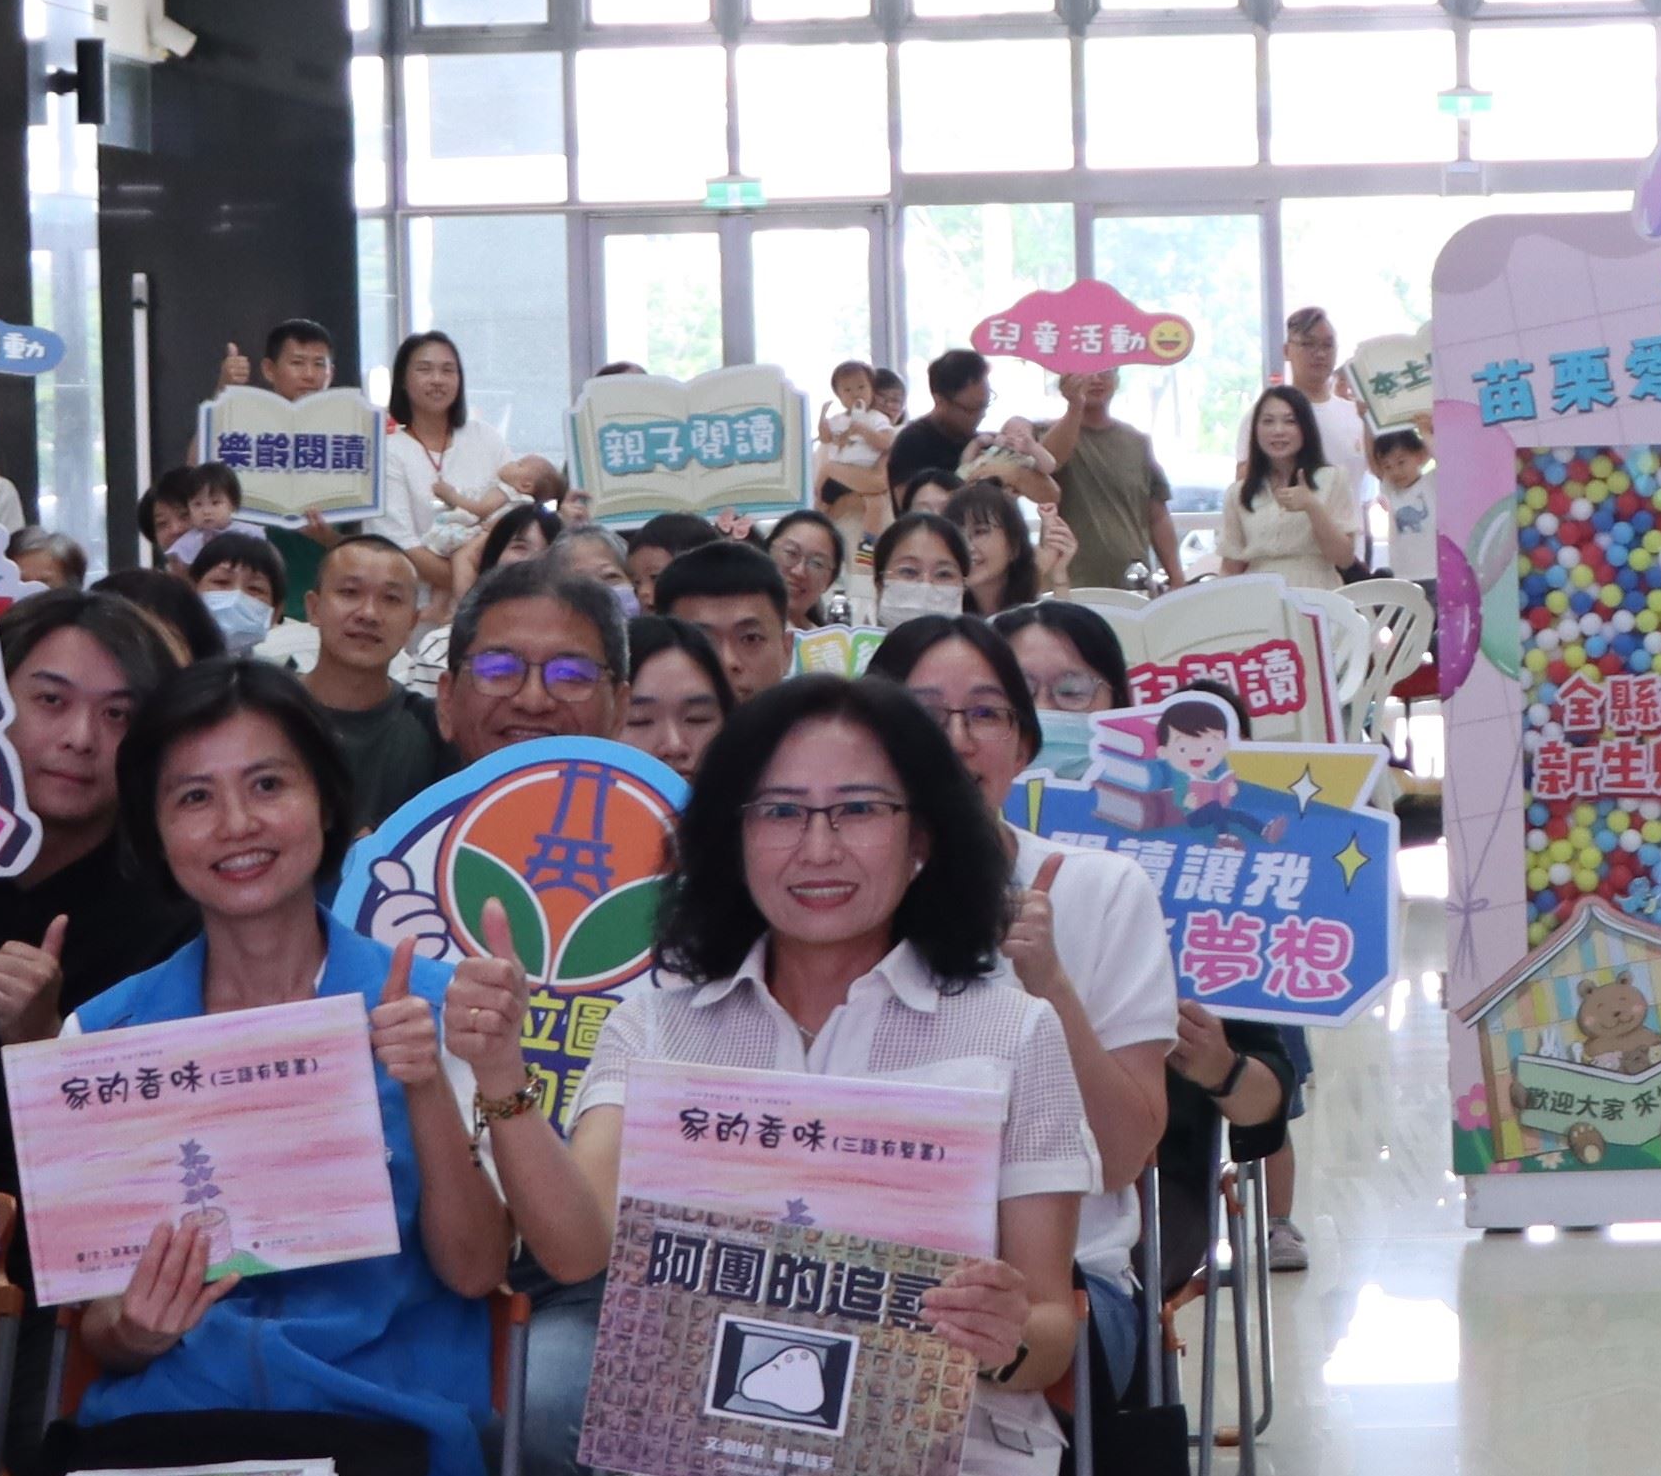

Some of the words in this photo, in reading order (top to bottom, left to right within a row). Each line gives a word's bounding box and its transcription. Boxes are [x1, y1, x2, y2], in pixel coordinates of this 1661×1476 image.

[987, 320, 1146, 355] 兒童活動
[1368, 353, 1432, 396] 本土
[217, 432, 369, 474] 樂齡閱讀
[602, 412, 777, 473] 親子閱讀
[61, 1060, 205, 1111] 家的香味
[679, 1107, 826, 1152] 家的香味
